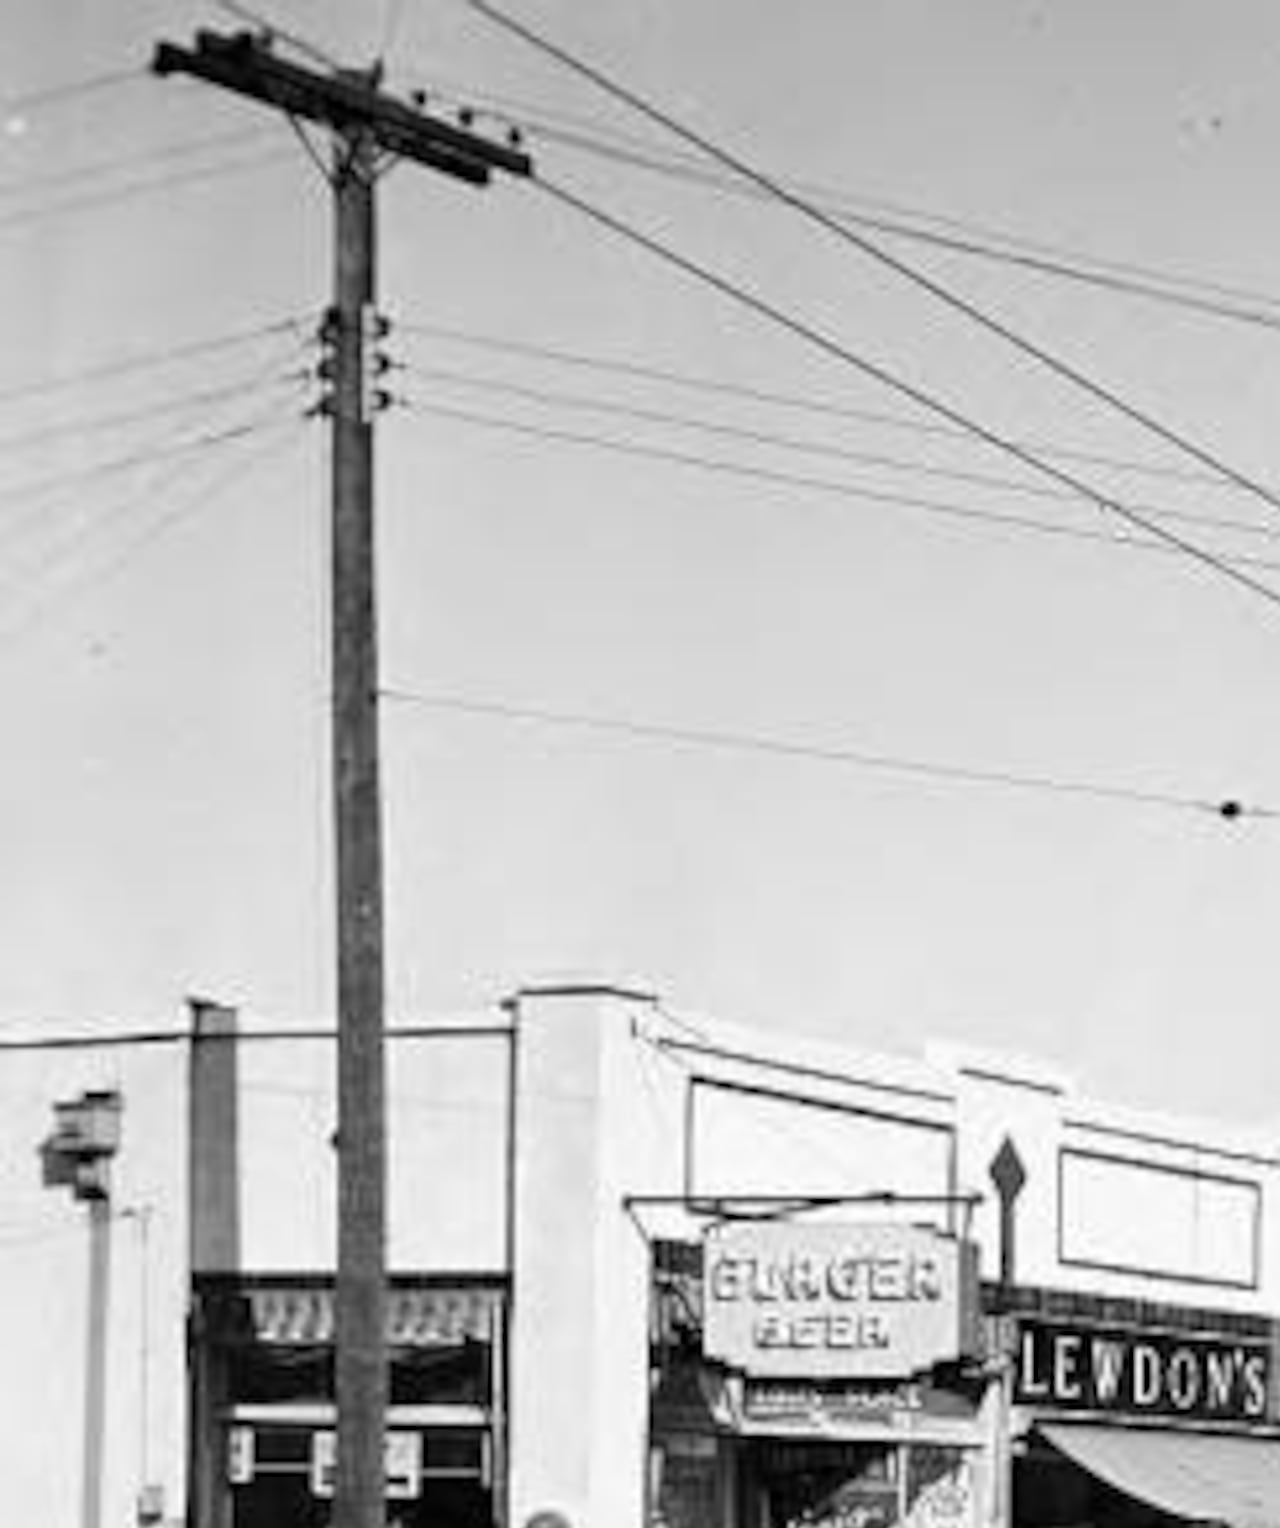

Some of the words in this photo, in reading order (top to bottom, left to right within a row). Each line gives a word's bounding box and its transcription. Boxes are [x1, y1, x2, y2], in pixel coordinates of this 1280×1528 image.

[711, 1253, 941, 1302] BURGER
[753, 1312, 888, 1348] BEER
[1021, 1329, 1268, 1416] LEWDON'S
